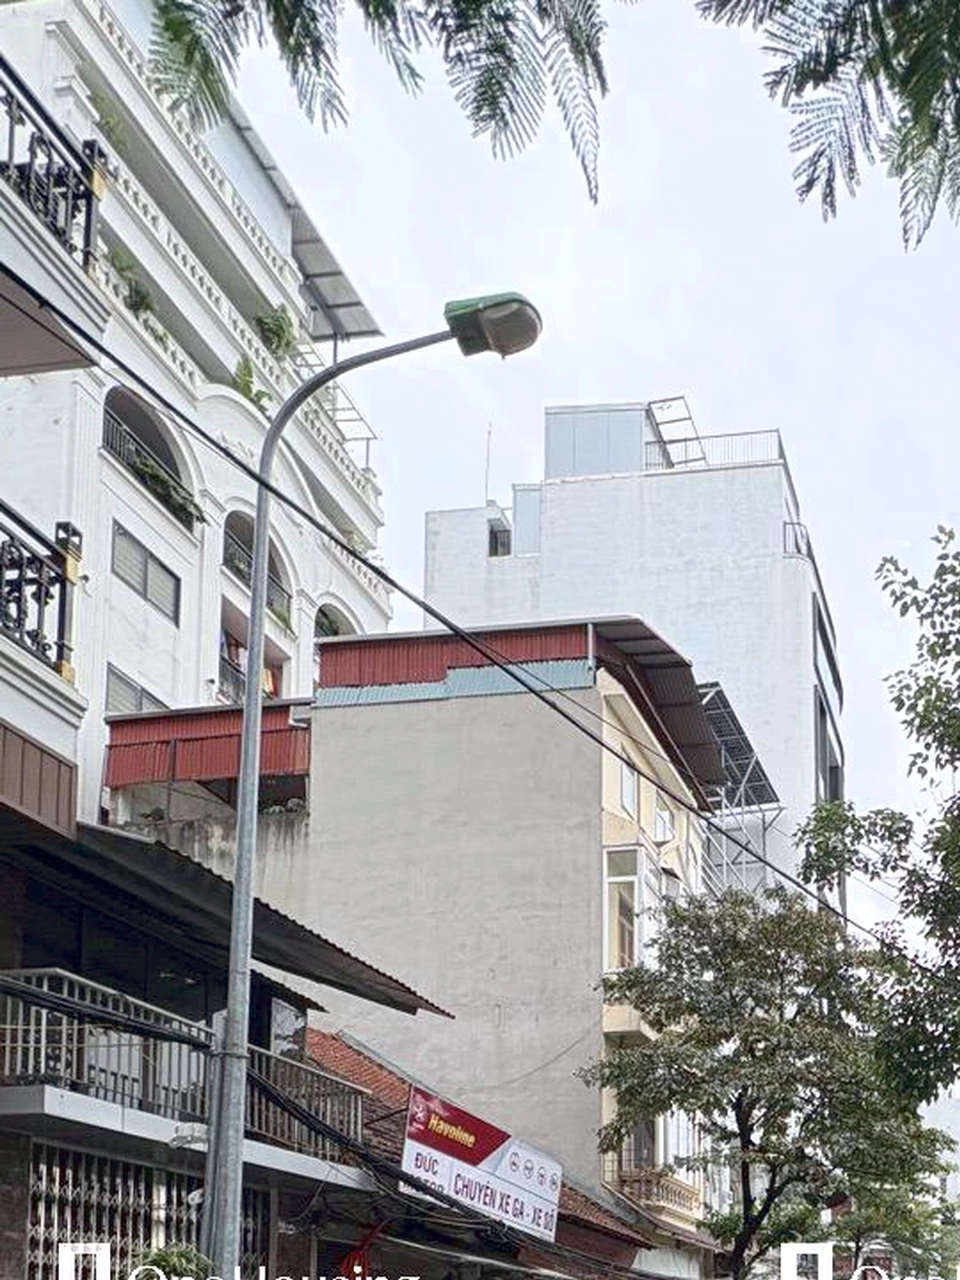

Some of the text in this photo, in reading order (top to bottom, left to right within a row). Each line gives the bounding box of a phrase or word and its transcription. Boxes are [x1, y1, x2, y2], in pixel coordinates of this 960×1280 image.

[427, 1113, 476, 1148] Havoline
[498, 1191, 512, 1214] XE
[512, 1198, 525, 1221] GA
